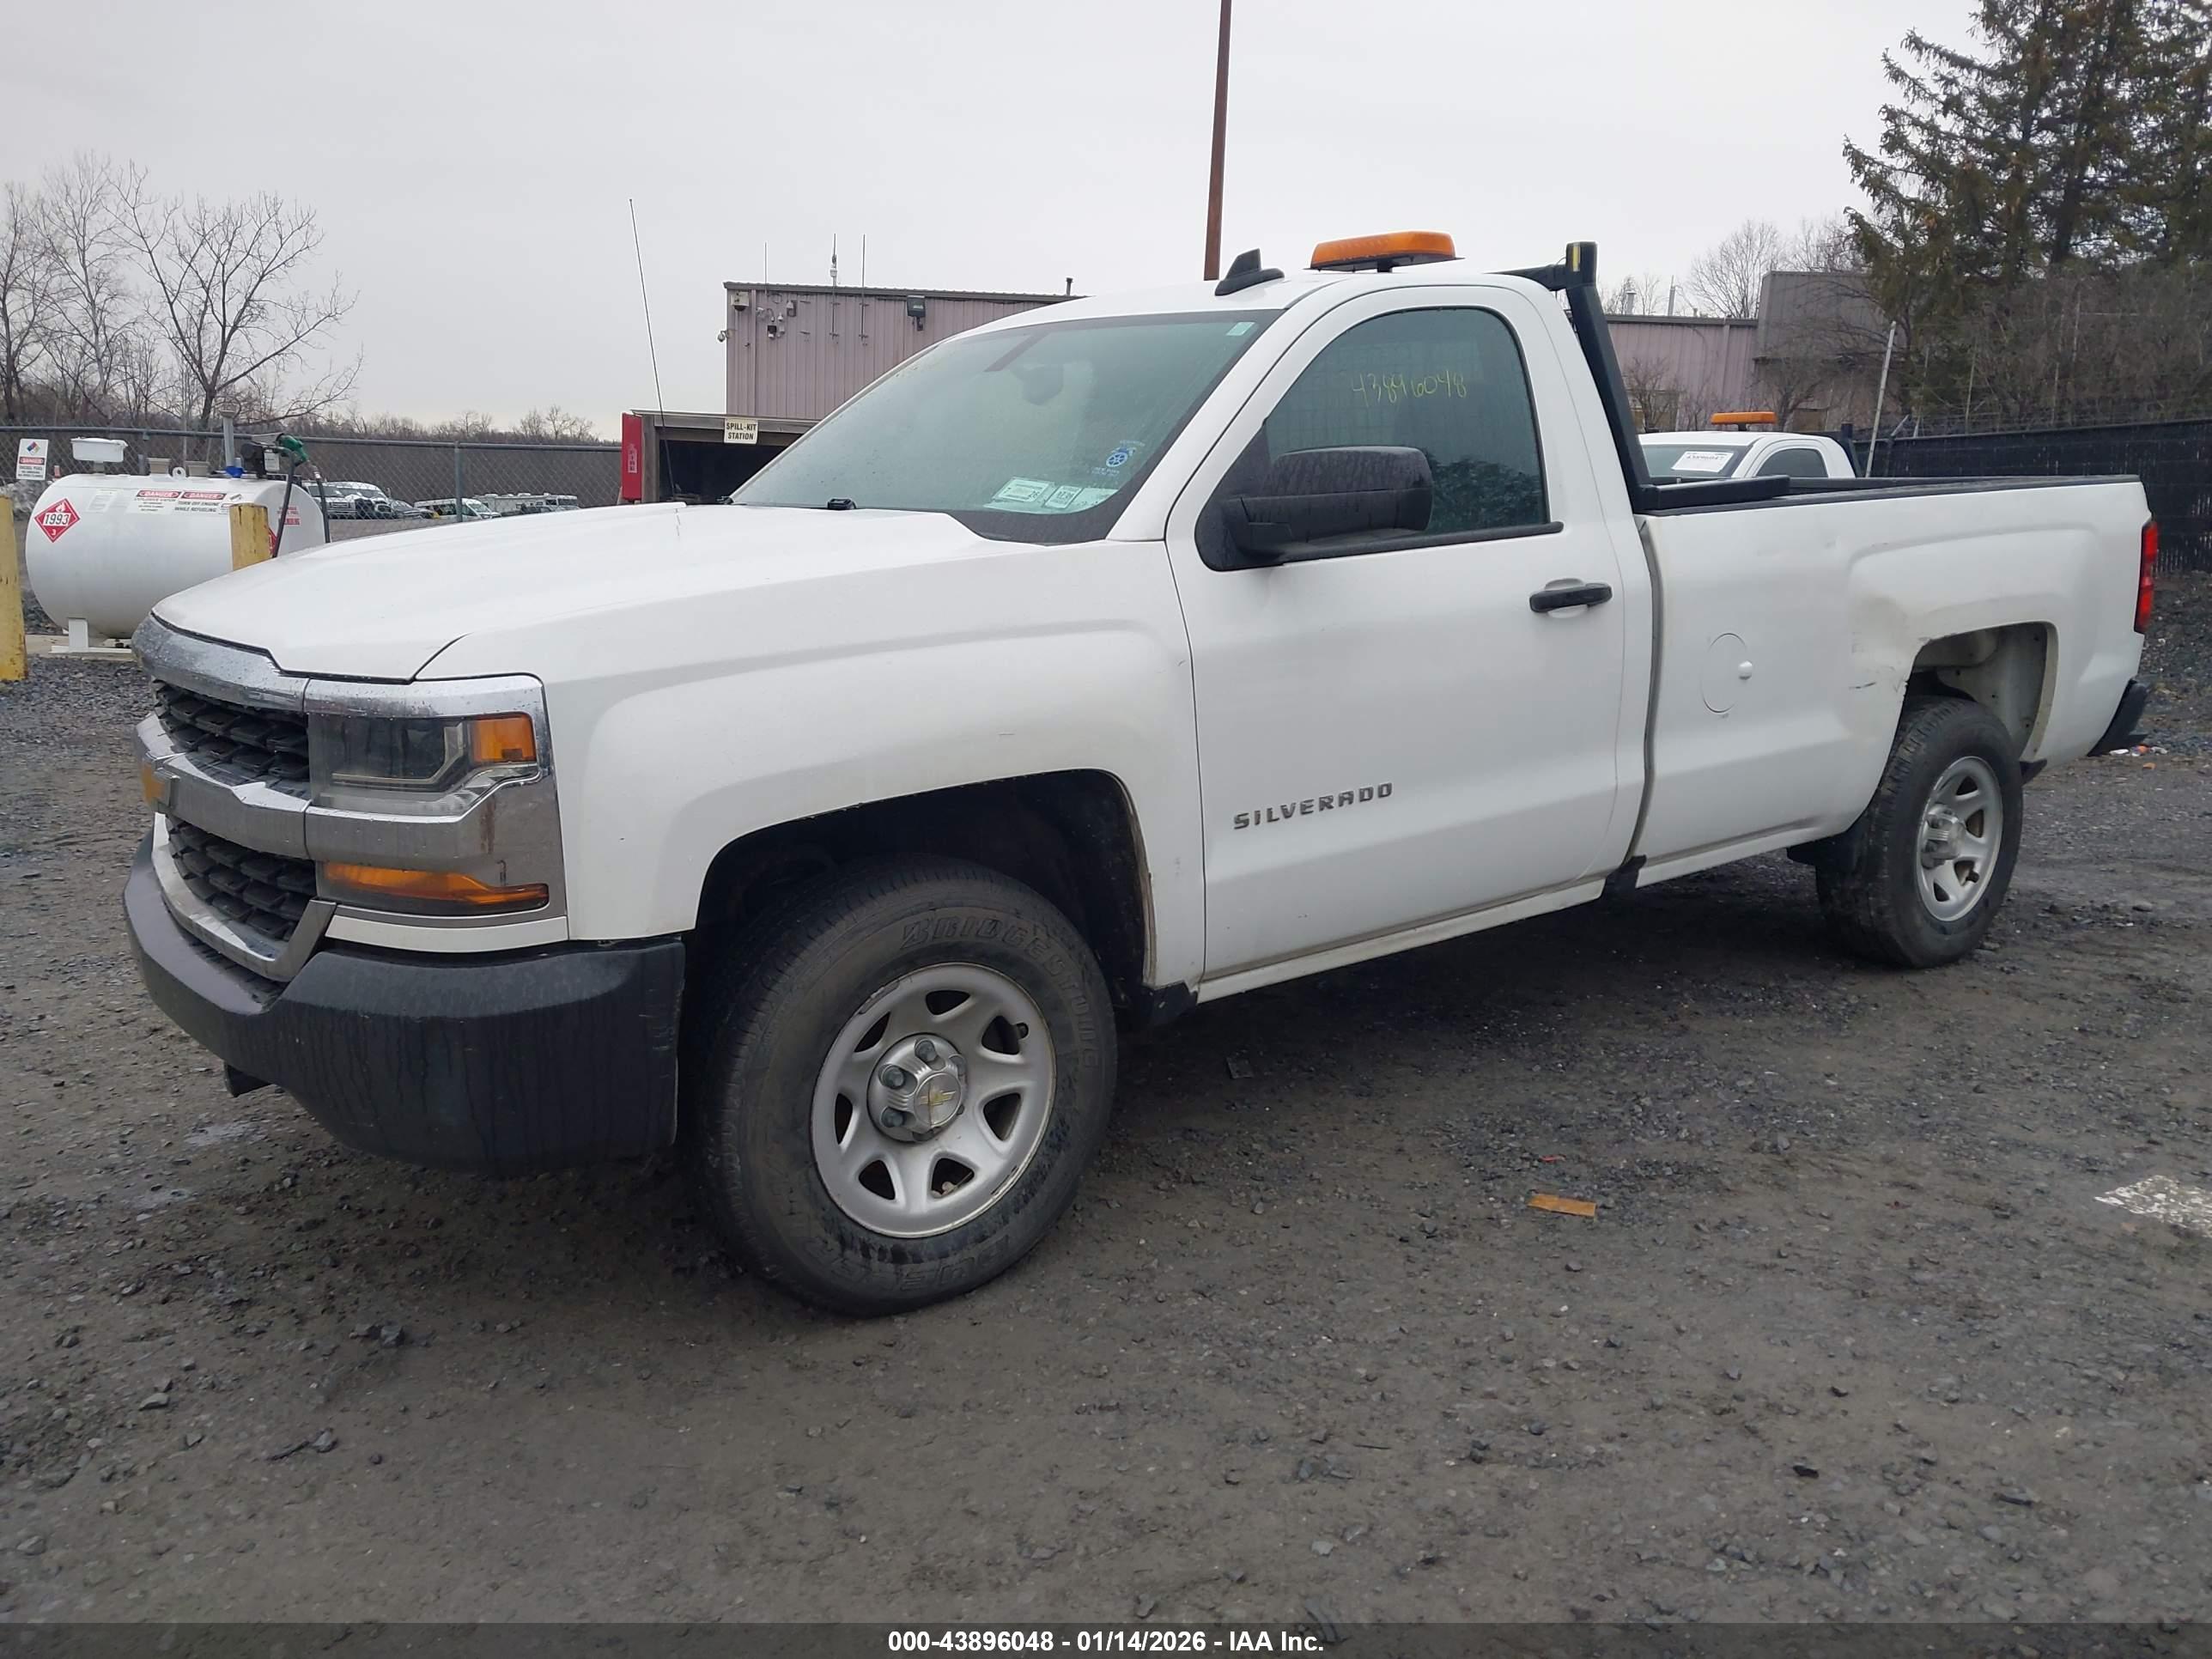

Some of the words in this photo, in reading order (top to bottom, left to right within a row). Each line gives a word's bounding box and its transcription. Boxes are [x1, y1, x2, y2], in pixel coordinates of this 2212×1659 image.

[726, 422, 757, 431] SPILL-KIT
[727, 432, 754, 441] STATION
[44, 514, 70, 526] 1993
[1234, 782, 1393, 830] SILVERADO
